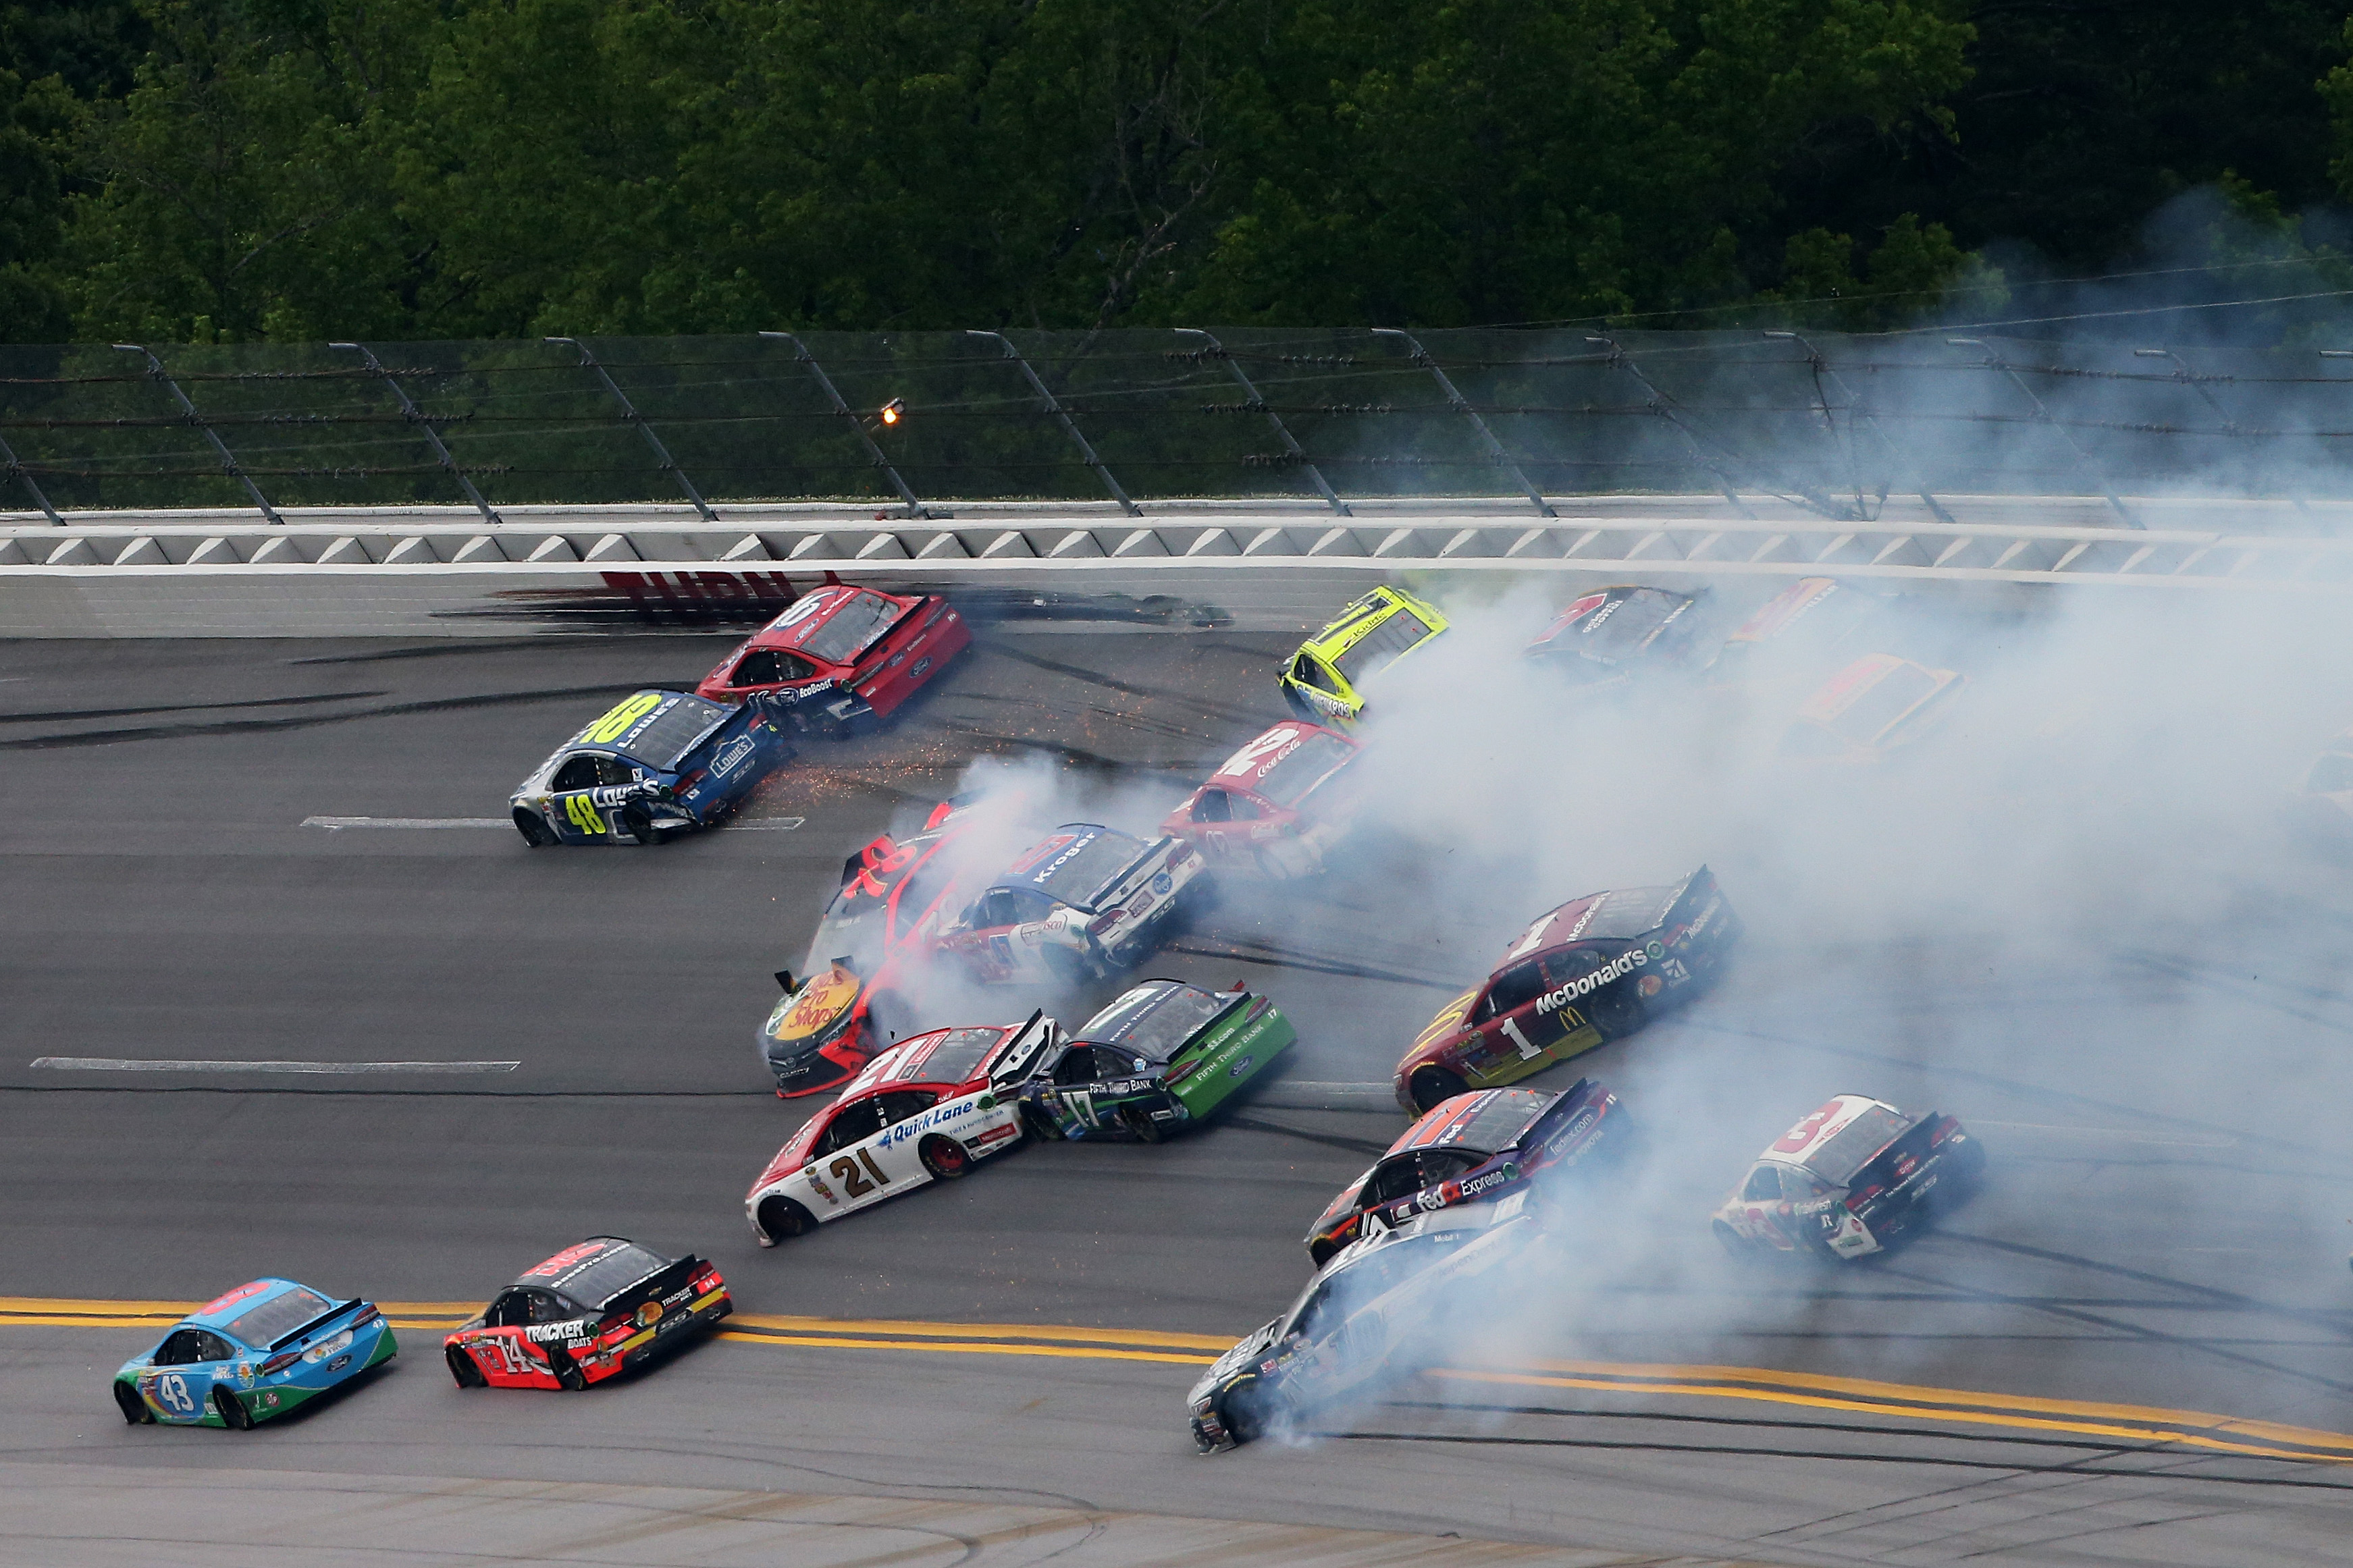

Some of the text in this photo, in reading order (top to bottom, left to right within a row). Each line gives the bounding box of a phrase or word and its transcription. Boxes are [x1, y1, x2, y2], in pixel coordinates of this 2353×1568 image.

[799, 678, 833, 699] EcoBoost
[565, 794, 606, 835] 48
[1033, 832, 1096, 884] Kroger
[1535, 948, 1648, 1015] McDonald's
[1268, 1008, 1278, 1020] 17
[1196, 1062, 1218, 1081] FIFTH
[1240, 1024, 1264, 1044] BANK
[1500, 1017, 1542, 1060] 1
[1090, 1083, 1107, 1094] FIFTH
[1131, 1079, 1152, 1091] BANK
[893, 1114, 931, 1143] Quick
[933, 1101, 973, 1125] Lane
[1061, 1090, 1101, 1128] 17
[1772, 1101, 1844, 1154] 3
[829, 1146, 891, 1199] 21
[1460, 1171, 1506, 1197] Express
[662, 1287, 691, 1307] TRACKER
[373, 1319, 384, 1329] 43
[525, 1320, 585, 1343] TRACKER
[567, 1336, 592, 1349] BOATS
[496, 1334, 533, 1374] 14
[161, 1374, 195, 1412] 43
